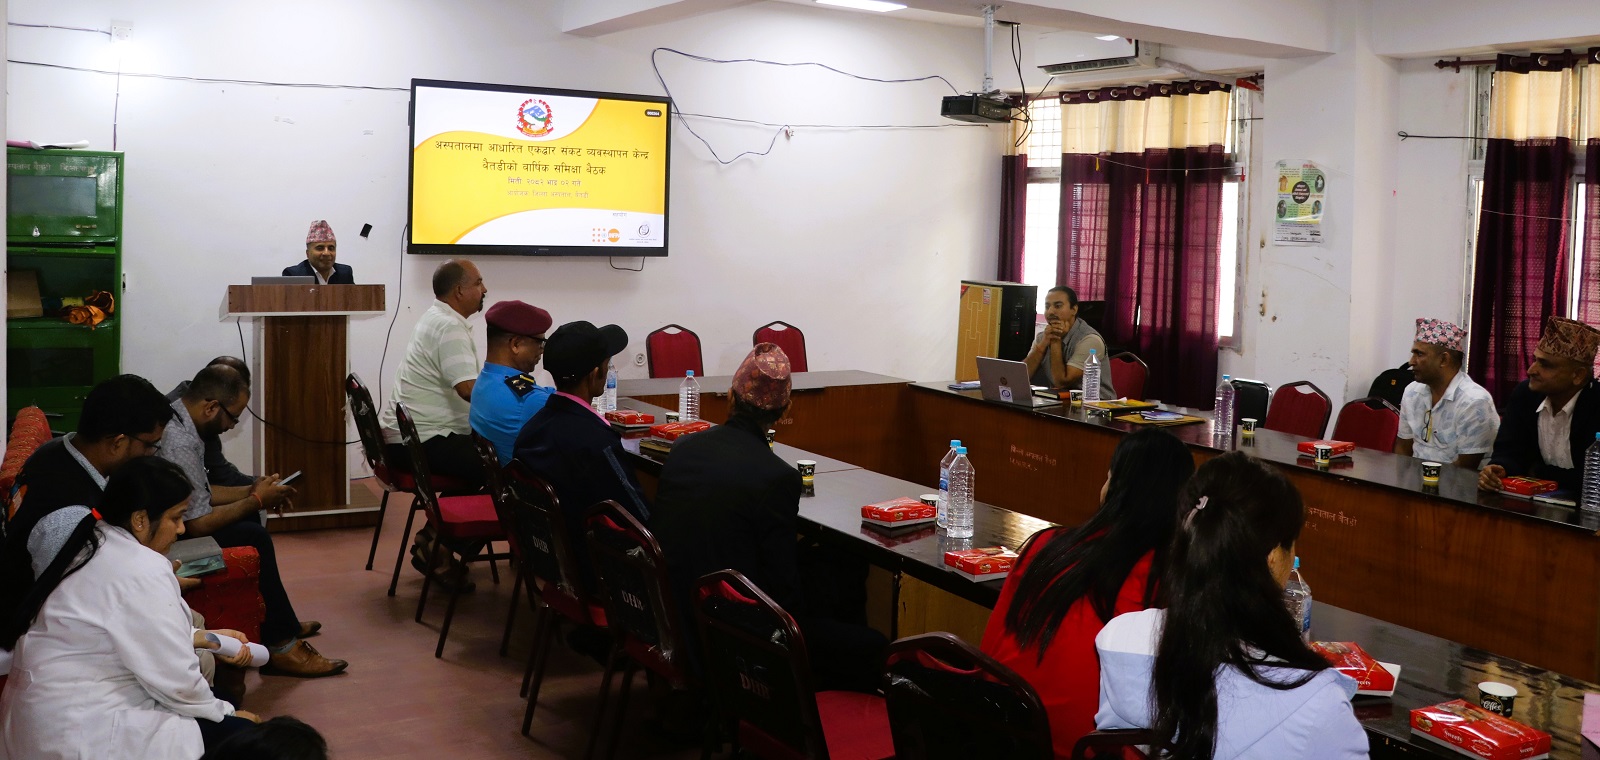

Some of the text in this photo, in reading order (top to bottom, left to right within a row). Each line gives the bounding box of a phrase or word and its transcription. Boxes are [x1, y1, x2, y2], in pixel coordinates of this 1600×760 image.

[435, 140, 483, 152] अस्पतालमा
[488, 142, 523, 153] आधारित
[527, 145, 557, 156] एकद्वार
[586, 148, 629, 159] व्यवस्थापन
[632, 148, 650, 160] केन्द्र
[522, 160, 550, 173] वार्षिक
[553, 162, 582, 174] समिक्षा
[586, 163, 607, 175] बैठक
[1483, 700, 1502, 711] Coffee
[1444, 728, 1463, 744] Sweets
